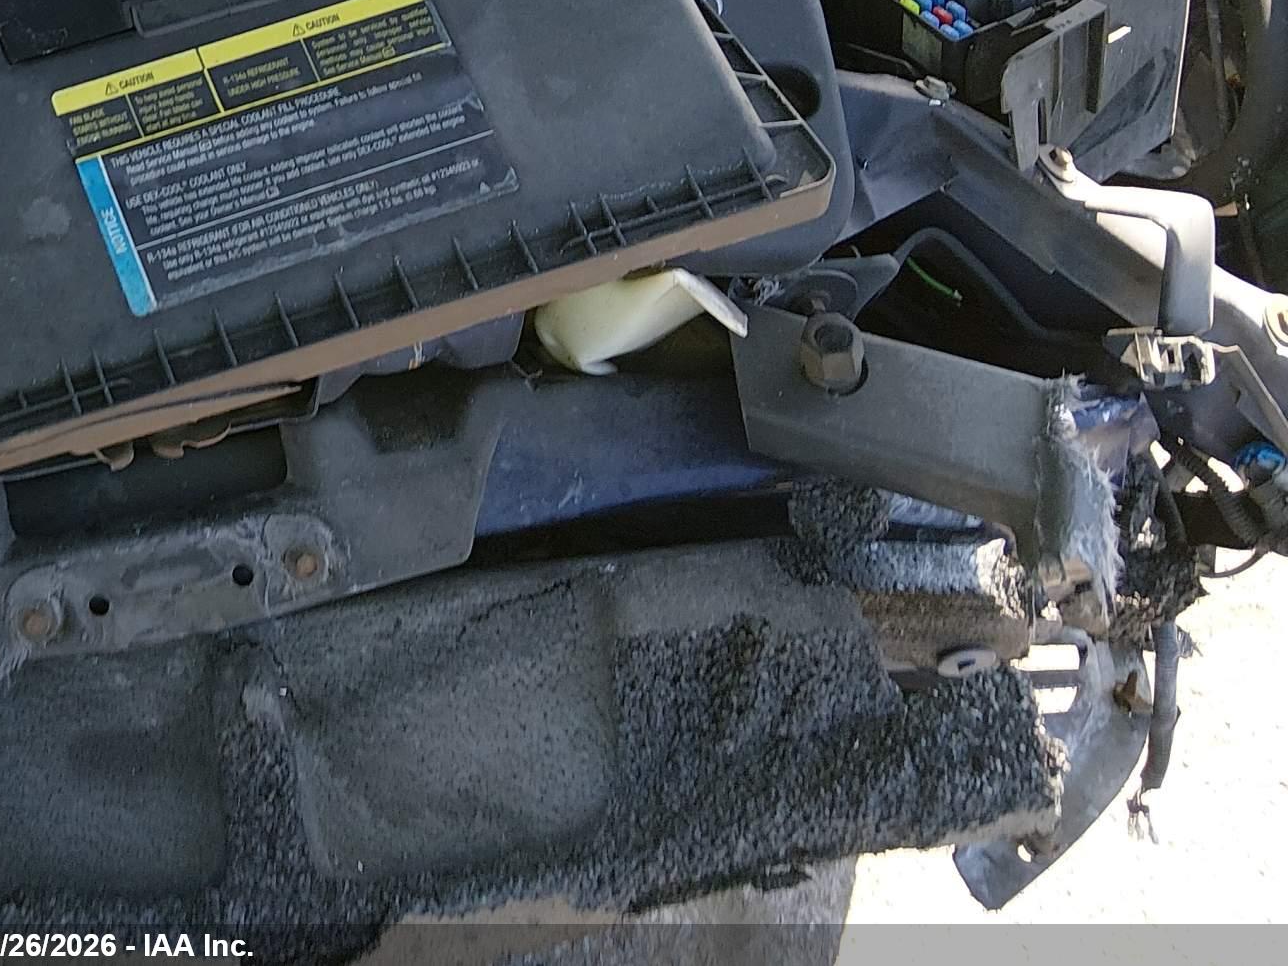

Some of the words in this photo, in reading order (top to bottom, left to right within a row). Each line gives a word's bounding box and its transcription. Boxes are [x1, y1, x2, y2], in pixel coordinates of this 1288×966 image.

[306, 15, 340, 30] CAUTION
[119, 73, 154, 89] CAUTION
[111, 154, 130, 168] THIS
[130, 144, 162, 162] VEHICLE
[163, 132, 201, 150] REQUIRES
[202, 129, 209, 138] A
[209, 120, 239, 136] SPECIAL
[241, 108, 276, 126] COOLANT
[278, 102, 295, 115] FILL
[126, 162, 145, 175] Read
[146, 154, 172, 169] Service
[126, 195, 142, 209] USE
[190, 169, 225, 188] COOLANT
[227, 162, 246, 176] ONLY
[100, 206, 127, 254] NOTICE
[147, 247, 177, 263] R-134a
[178, 228, 229, 252] REFRIGERANT
[251, 216, 265, 229] AIR
[266, 200, 318, 223] CONDITIONED
[318, 187, 355, 206] VEHICLES
